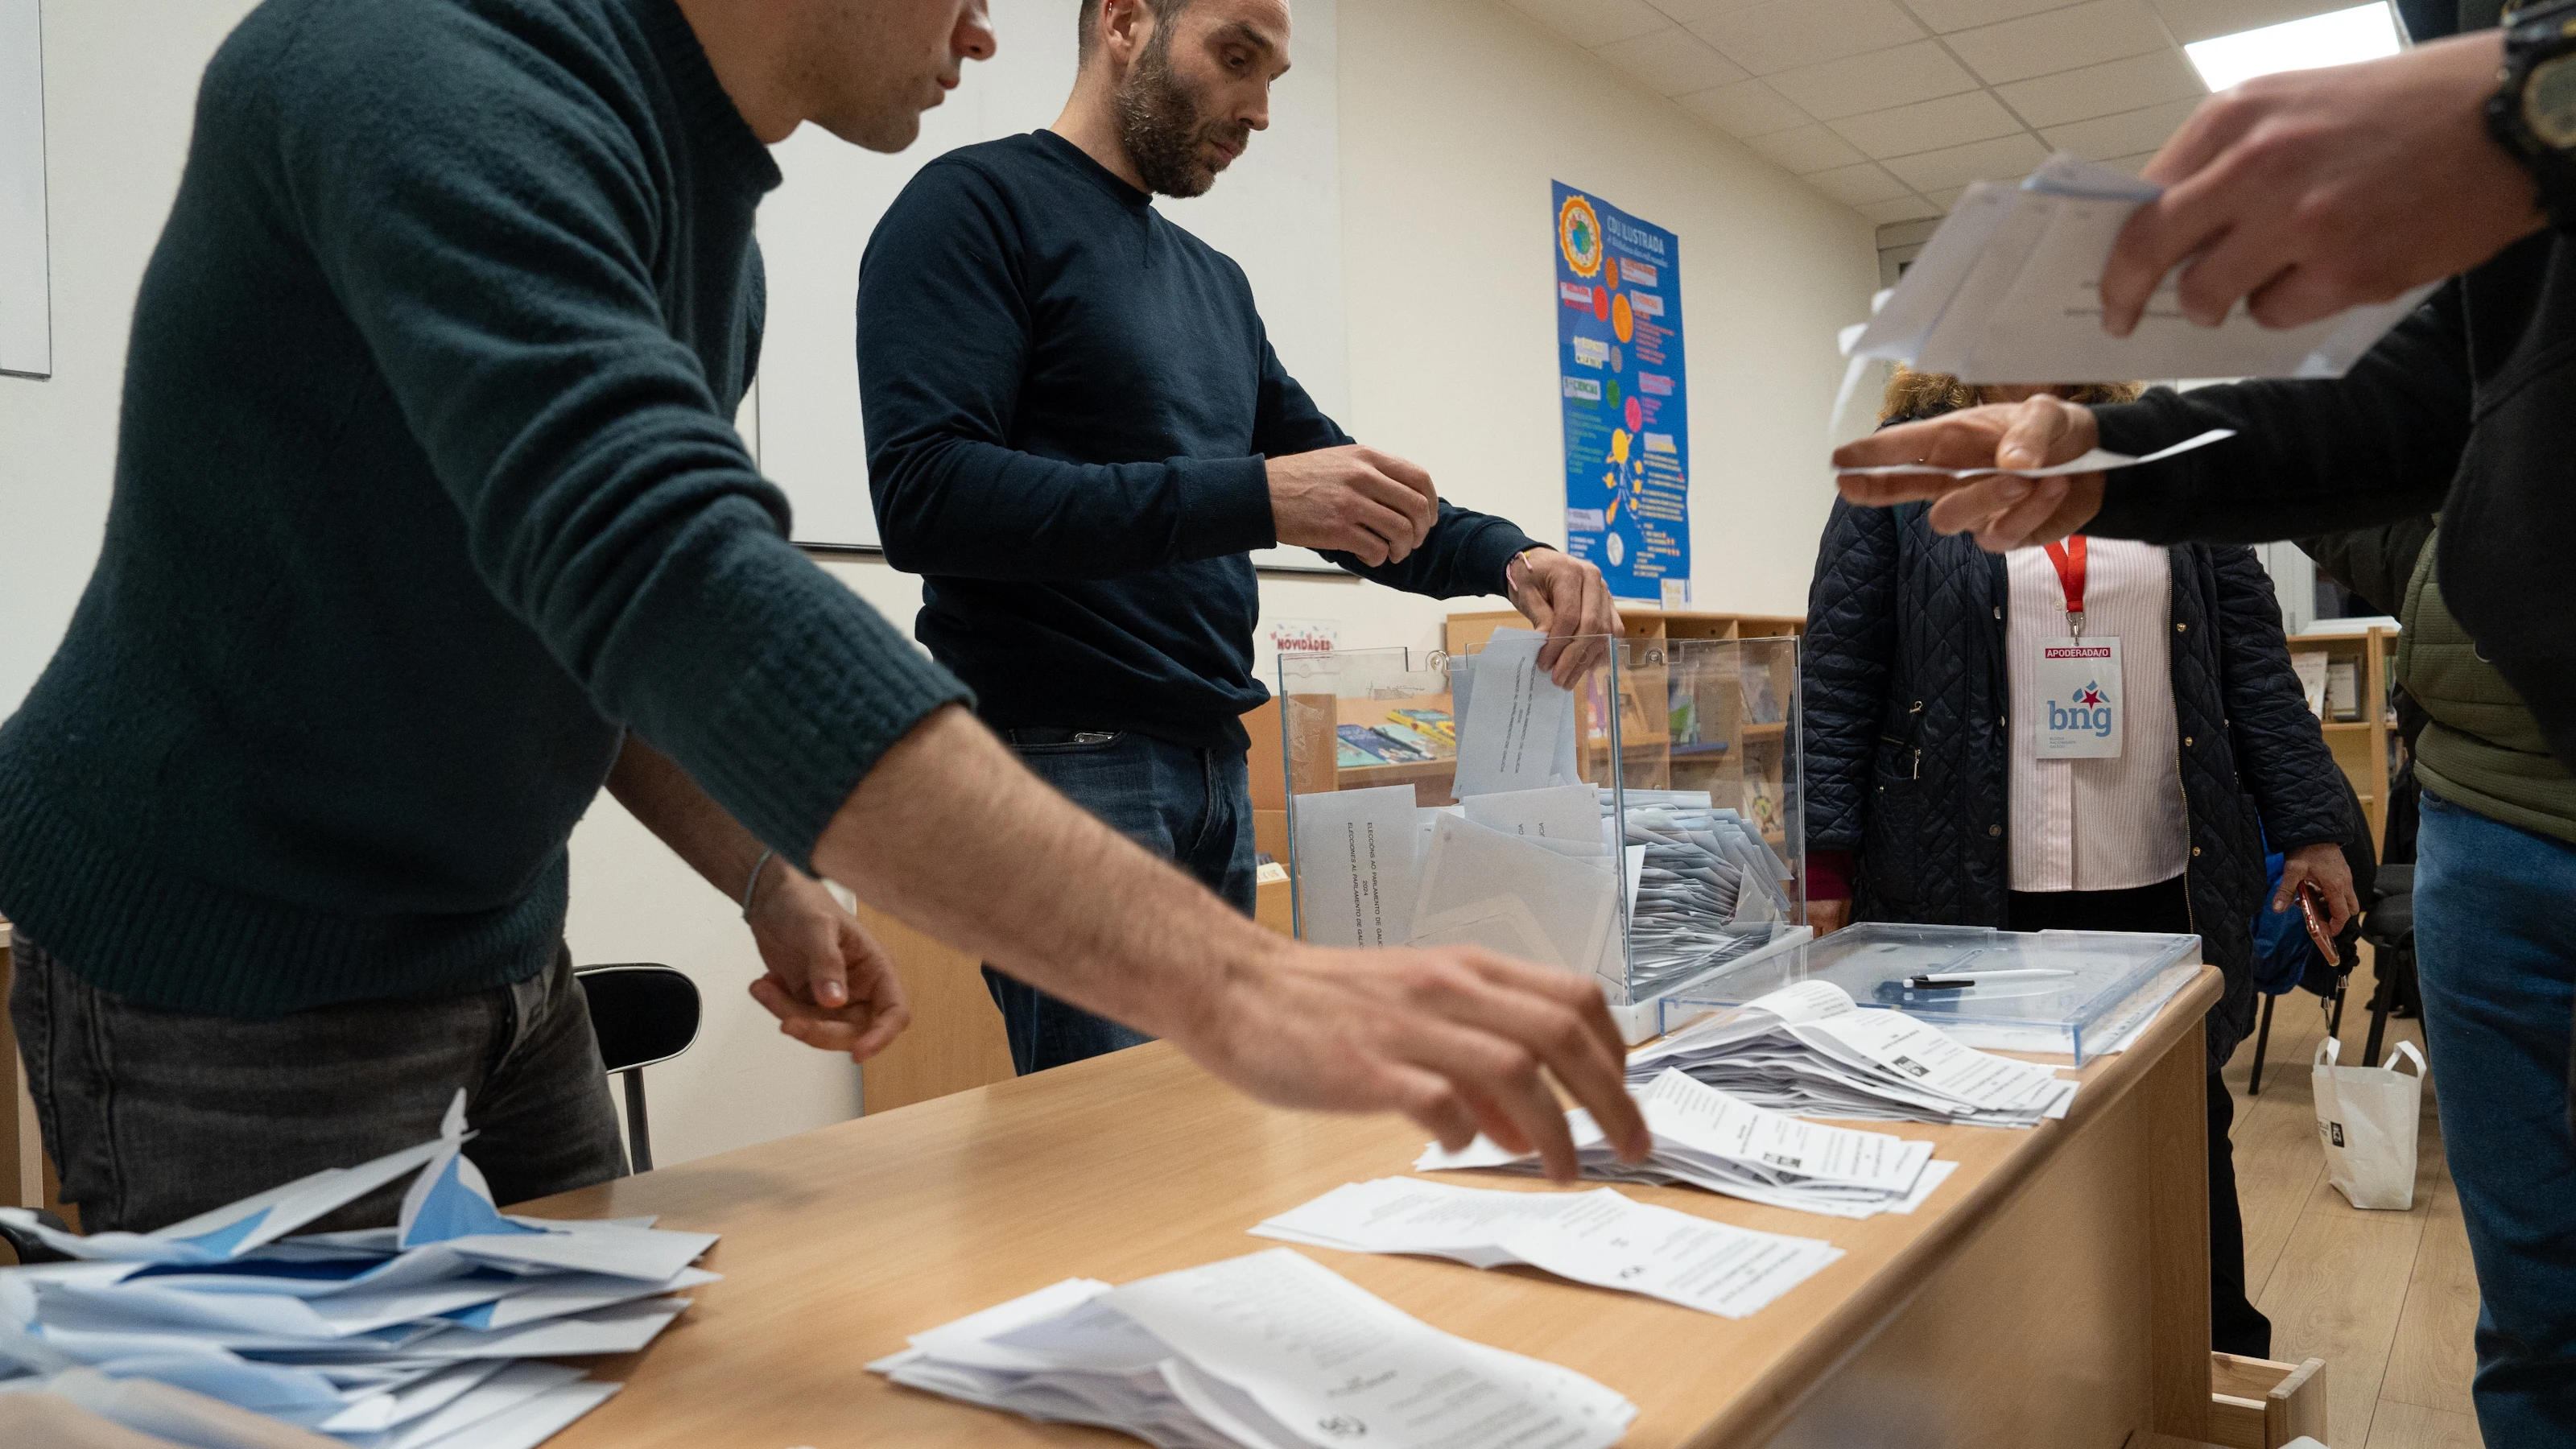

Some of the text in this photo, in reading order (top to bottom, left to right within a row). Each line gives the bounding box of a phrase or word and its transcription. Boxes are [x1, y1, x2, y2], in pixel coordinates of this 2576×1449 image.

[1621, 223, 1665, 255] ILUSTRADA
[1277, 638, 1331, 651] NOVIDADES
[2046, 648, 2109, 658] APODERADA/O
[2046, 700, 2112, 737] bng
[1348, 822, 1356, 863] ELECCIONES
[1367, 822, 1375, 858] ELECCIÓNS
[1352, 864, 1357, 872] AL
[1371, 860, 1377, 869] AO
[1352, 873, 1361, 917] PARLAMENTO
[1372, 872, 1381, 914] PARLAMENTO
[1356, 918, 1362, 927] DE
[1375, 917, 1381, 926] DE
